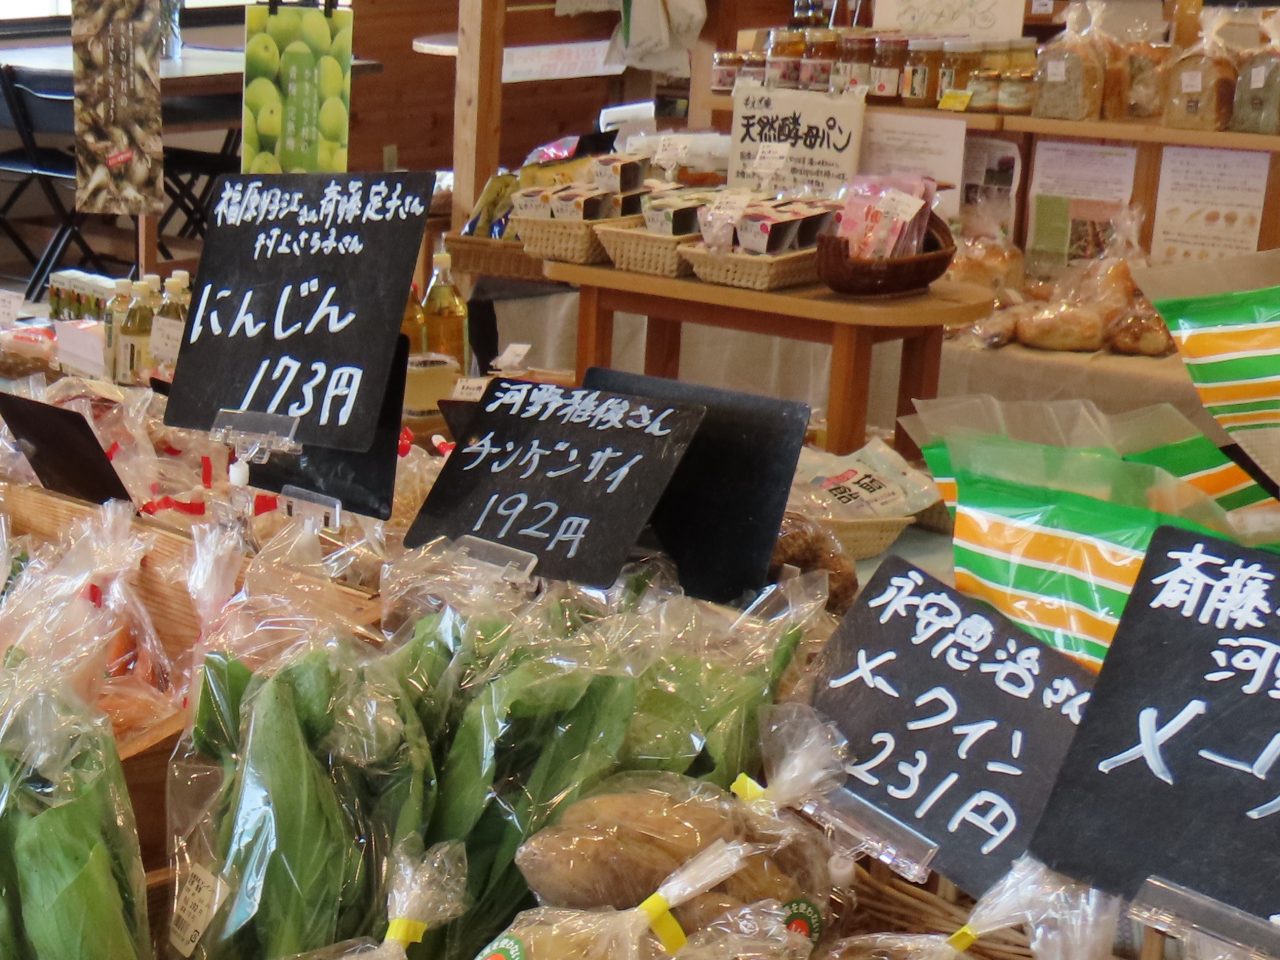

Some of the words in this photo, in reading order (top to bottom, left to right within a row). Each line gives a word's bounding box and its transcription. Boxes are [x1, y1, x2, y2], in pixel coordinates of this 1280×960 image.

[740, 111, 852, 152] 天然酵母パン
[191, 277, 356, 344] にんじん
[238, 355, 364, 427] 173円
[462, 431, 644, 494] チンゲンサイ
[472, 492, 591, 559] 192円
[1204, 636, 1280, 699] 河
[845, 732, 1018, 856] 231円
